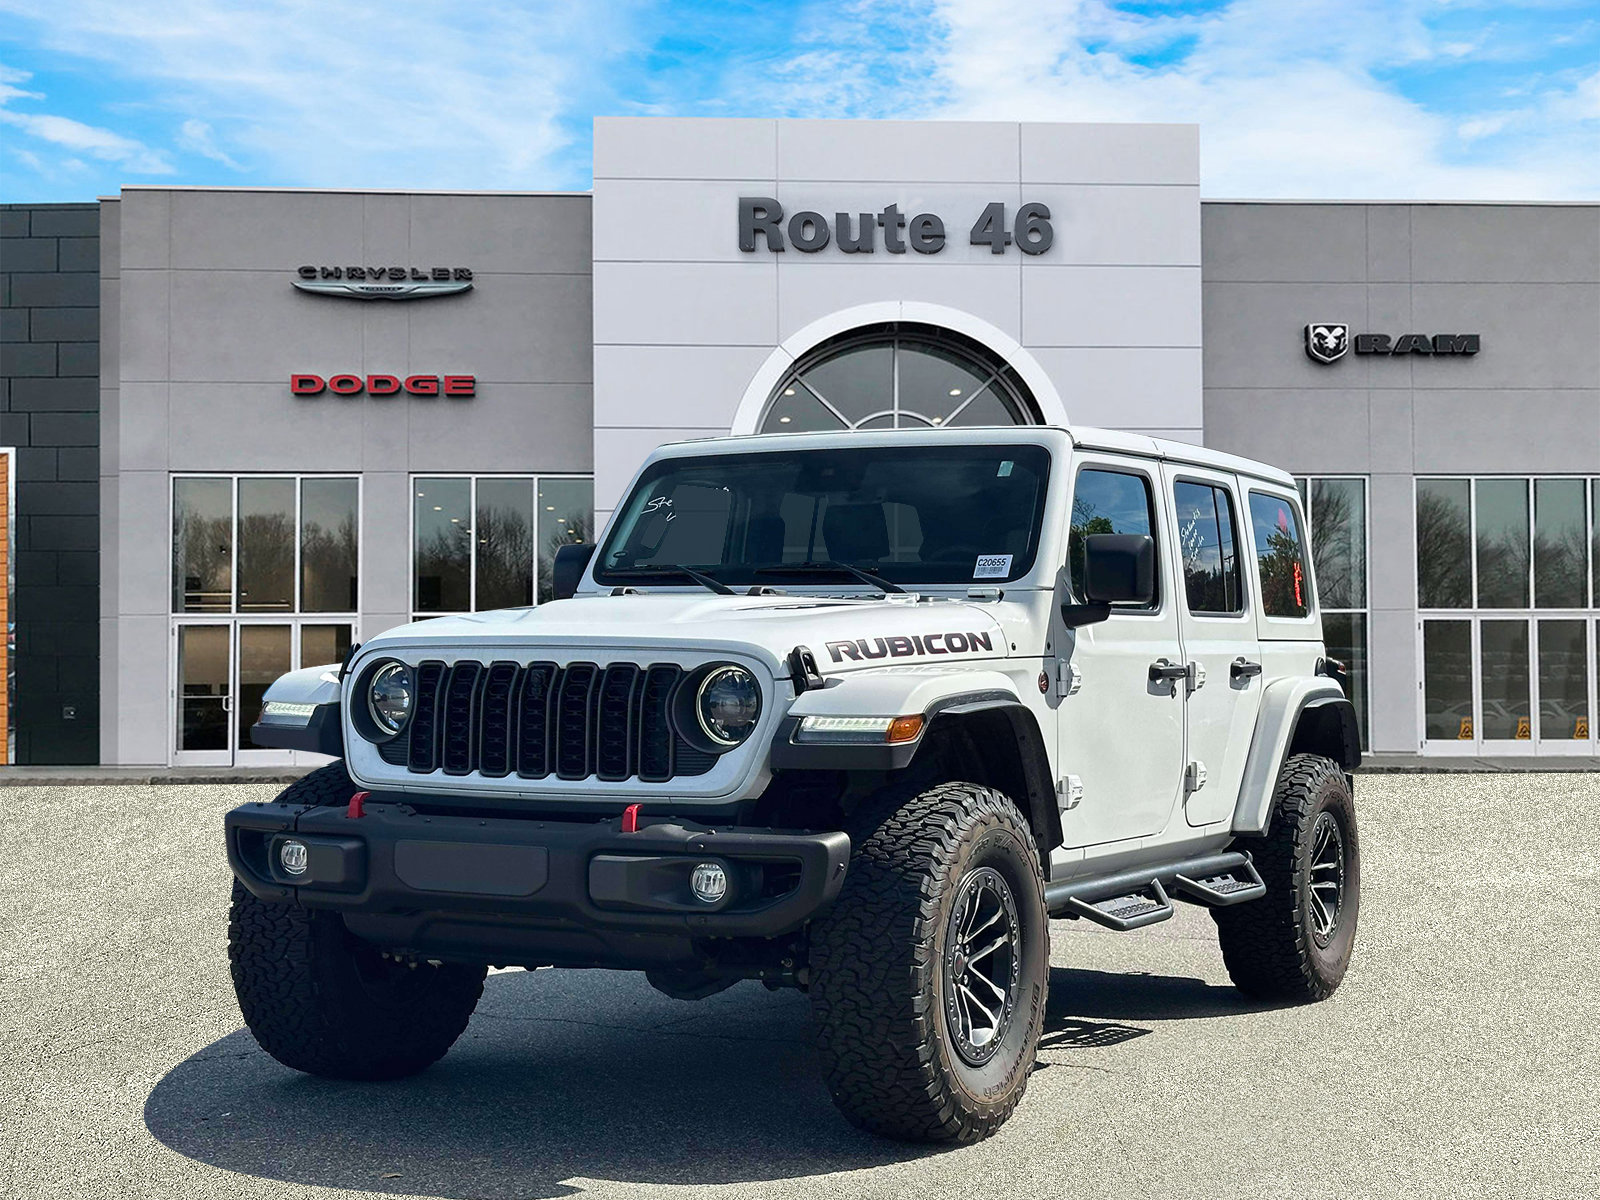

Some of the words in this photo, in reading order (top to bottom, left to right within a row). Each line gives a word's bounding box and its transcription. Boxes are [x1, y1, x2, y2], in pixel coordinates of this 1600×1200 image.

[738, 197, 946, 255] Route
[969, 202, 1054, 256] 46
[297, 265, 473, 281] CHRYSLER
[1354, 334, 1480, 355] RAM
[291, 374, 476, 396] DODGE
[977, 558, 1007, 567] C20655
[825, 631, 993, 663] RUBICON
